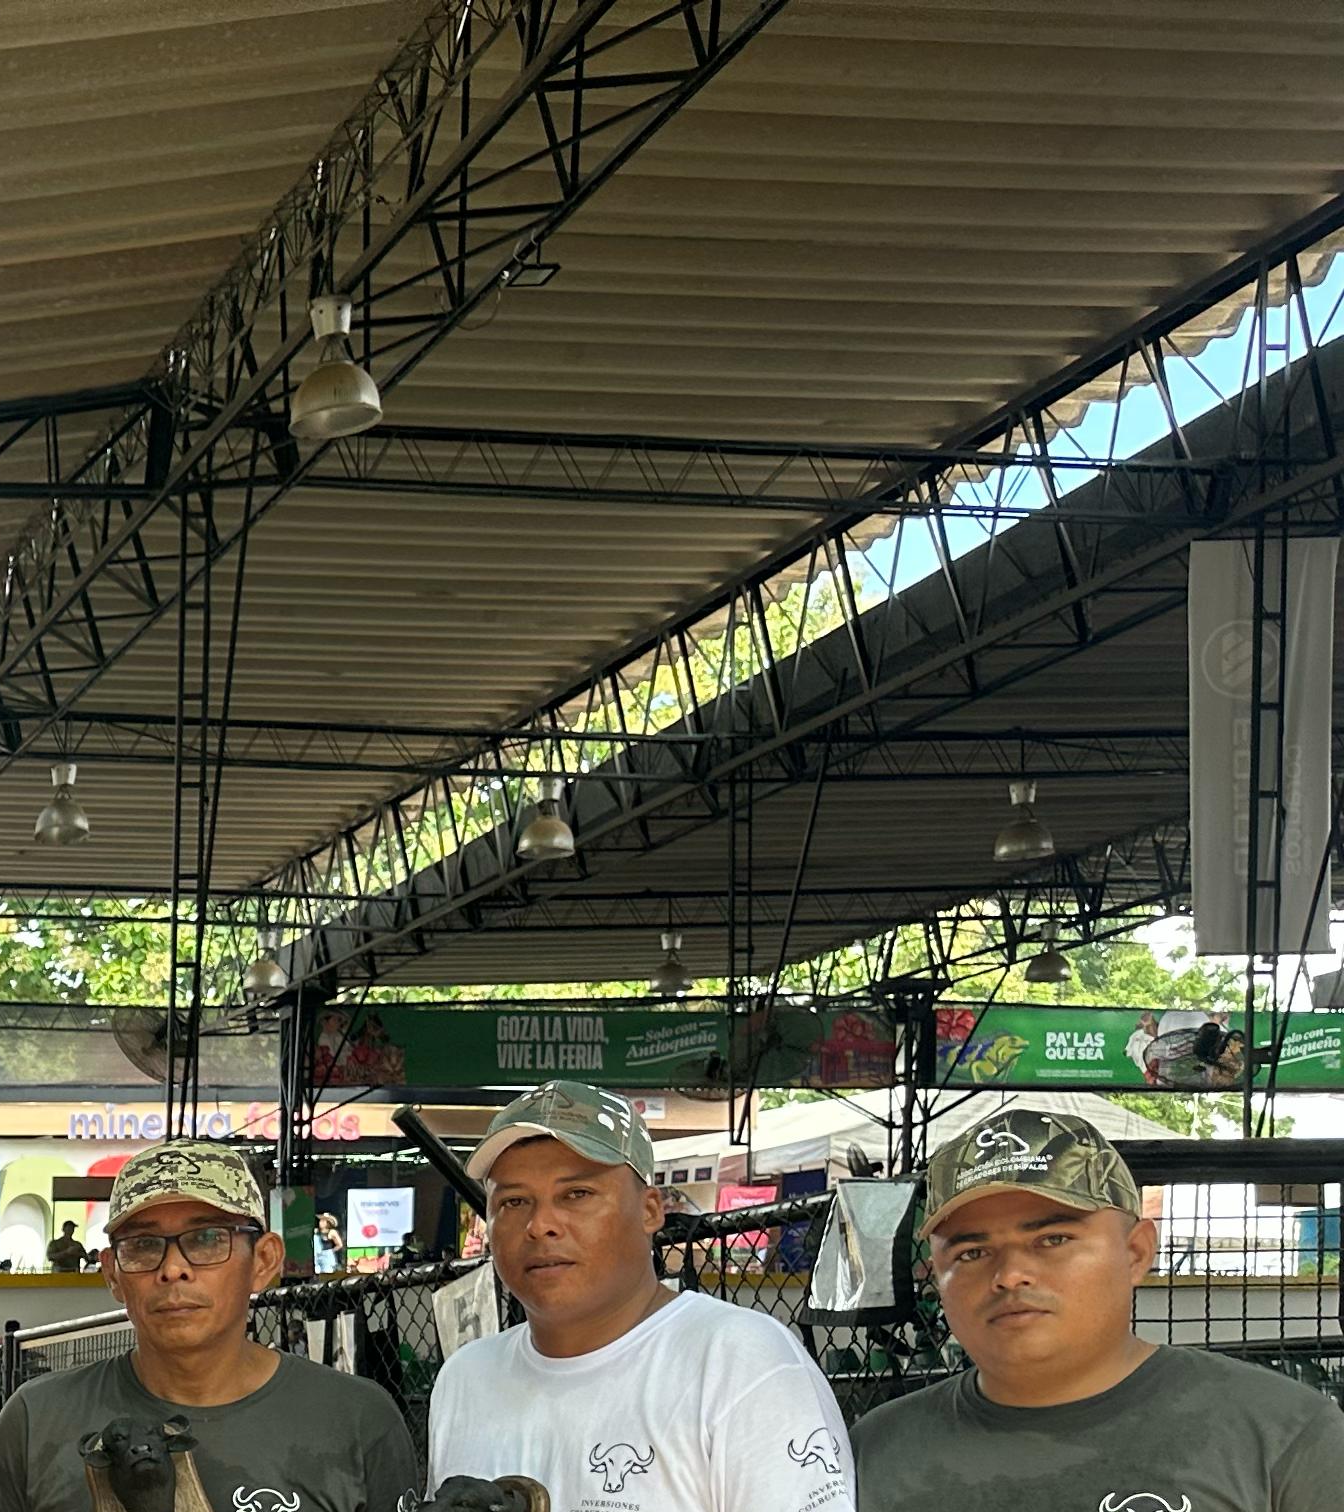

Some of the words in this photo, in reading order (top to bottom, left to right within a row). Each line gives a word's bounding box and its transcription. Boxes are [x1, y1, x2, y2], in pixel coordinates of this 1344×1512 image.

[497, 1016, 541, 1042] GOZA
[543, 1016, 563, 1042] LA
[566, 1016, 609, 1045] VIDA,
[645, 1026, 673, 1043] Solo
[674, 1021, 698, 1036] con
[1073, 1032, 1105, 1048] LAS
[1304, 1029, 1324, 1040] con
[626, 1031, 717, 1059] Antioqueño
[1045, 1048, 1075, 1060] QUE
[1077, 1048, 1104, 1060] SEA
[497, 1044, 533, 1069] VIVE
[536, 1044, 556, 1069] LA
[558, 1044, 603, 1069] FERIA
[69, 1104, 233, 1140] mineva
[580, 1499, 640, 1512] INVERSIONES
